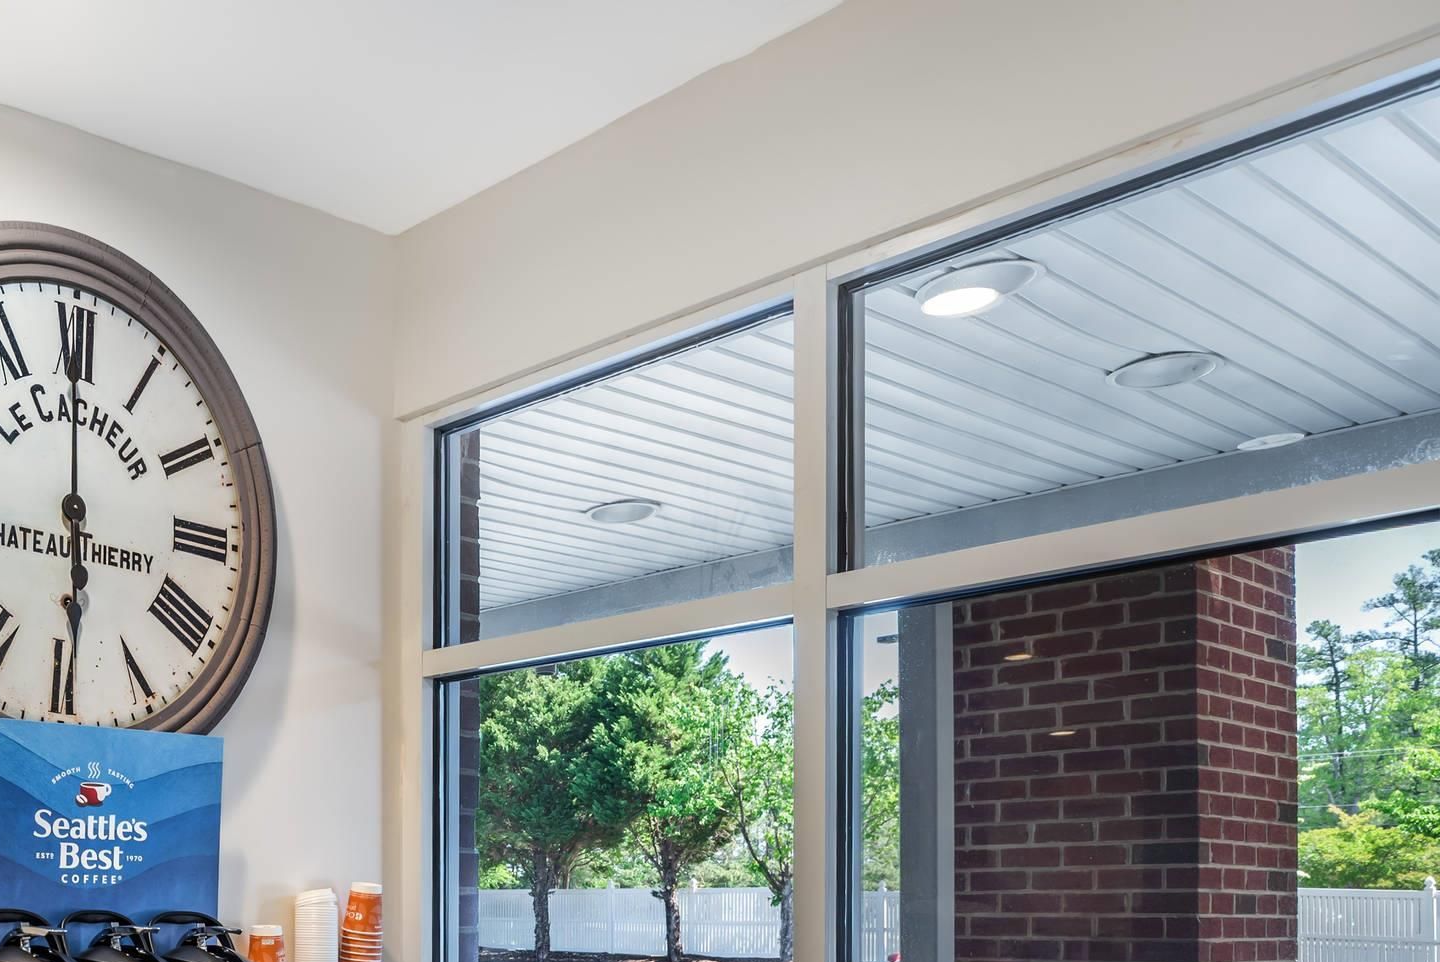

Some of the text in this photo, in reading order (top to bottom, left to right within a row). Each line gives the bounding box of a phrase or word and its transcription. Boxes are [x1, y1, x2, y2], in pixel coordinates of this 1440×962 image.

[122, 355, 162, 415] I
[29, 383, 148, 481] CACHEUR
[158, 433, 215, 479] II
[76, 530, 155, 575] THIERRY
[172, 515, 228, 566] III
[118, 634, 157, 706] V
[51, 766, 135, 789] SMOOTH TASTING
[33, 808, 148, 842] Seattle's
[59, 842, 124, 870] Best
